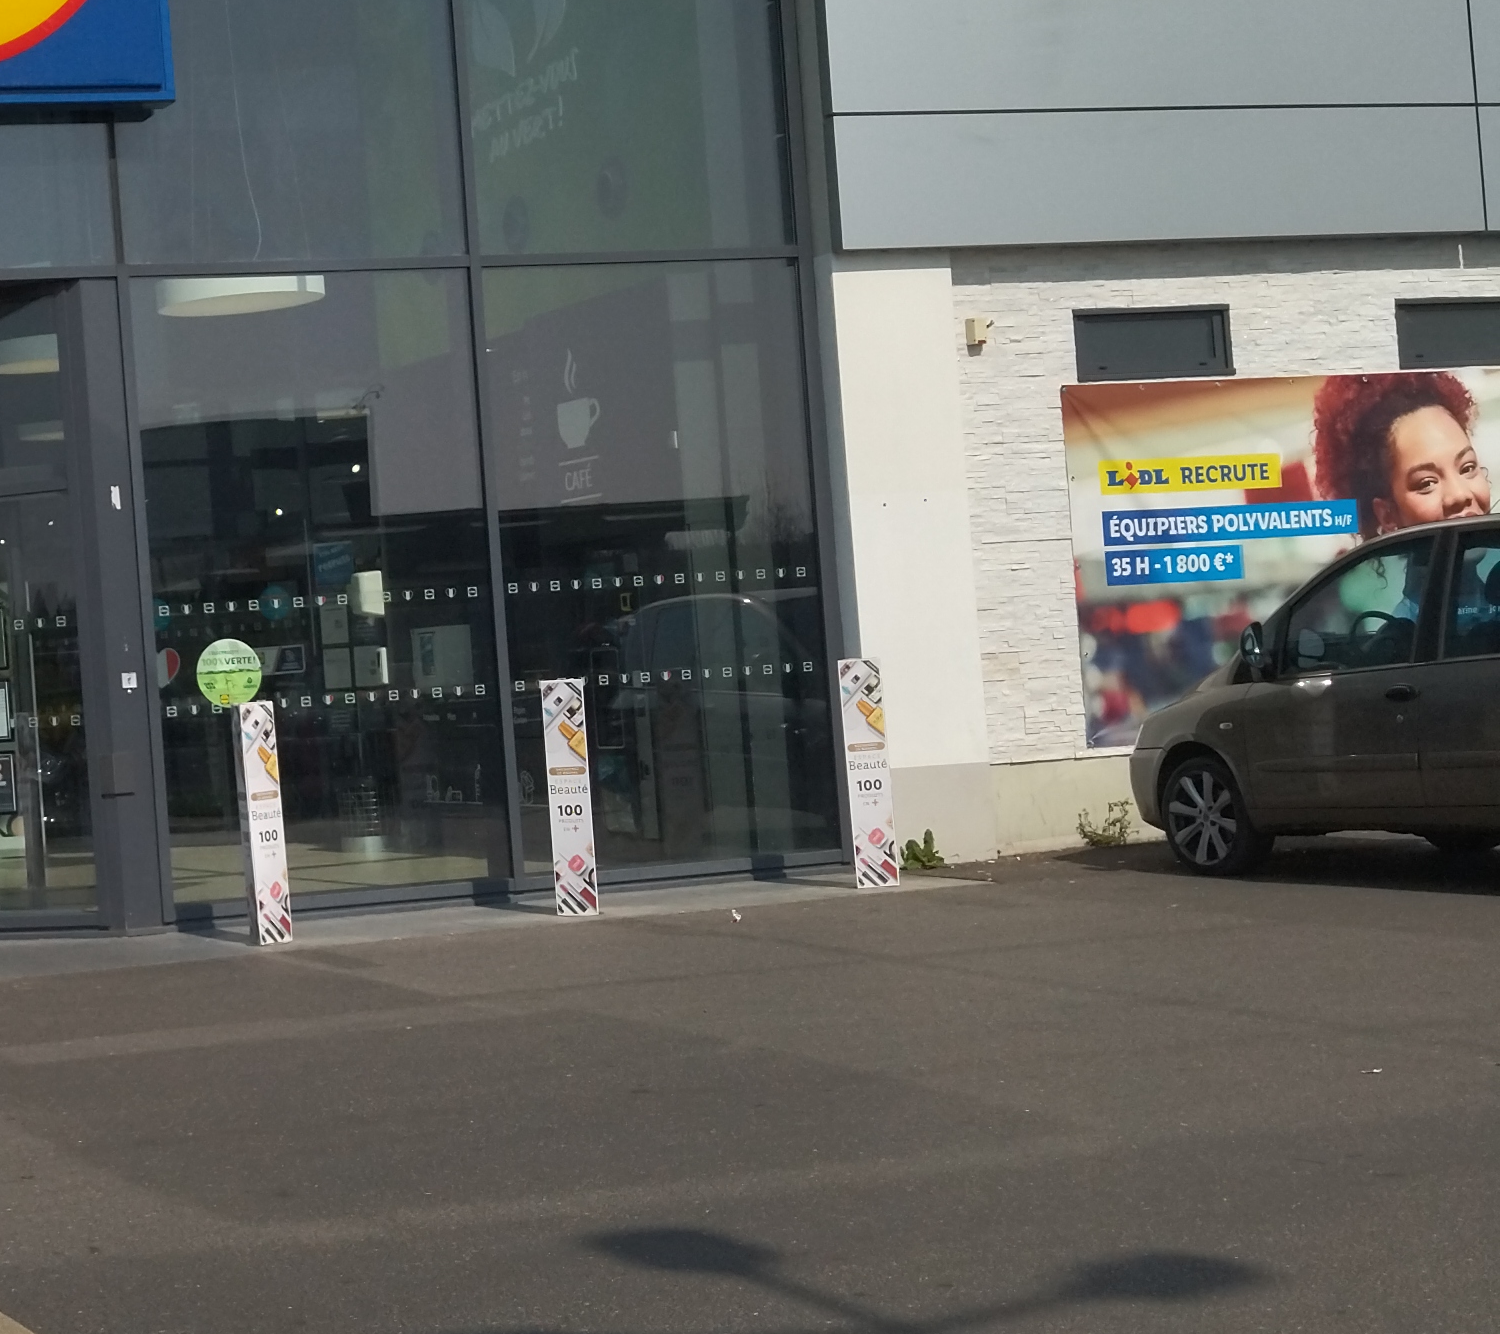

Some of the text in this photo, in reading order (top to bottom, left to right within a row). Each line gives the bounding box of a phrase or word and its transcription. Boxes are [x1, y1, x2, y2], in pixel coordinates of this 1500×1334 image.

[564, 462, 593, 492] CAFÉ
[1180, 463, 1270, 485] RECRUTE
[1109, 508, 1353, 541] ÉQUIPIERS POLYVALENTS H/F
[1111, 557, 1132, 577] 35
[1135, 556, 1150, 575] H
[848, 759, 888, 771] Beauté
[550, 784, 589, 795] Beauté
[856, 779, 883, 792] 100
[251, 807, 282, 821] Beauté
[557, 804, 583, 817] 100
[259, 829, 278, 843] 100
